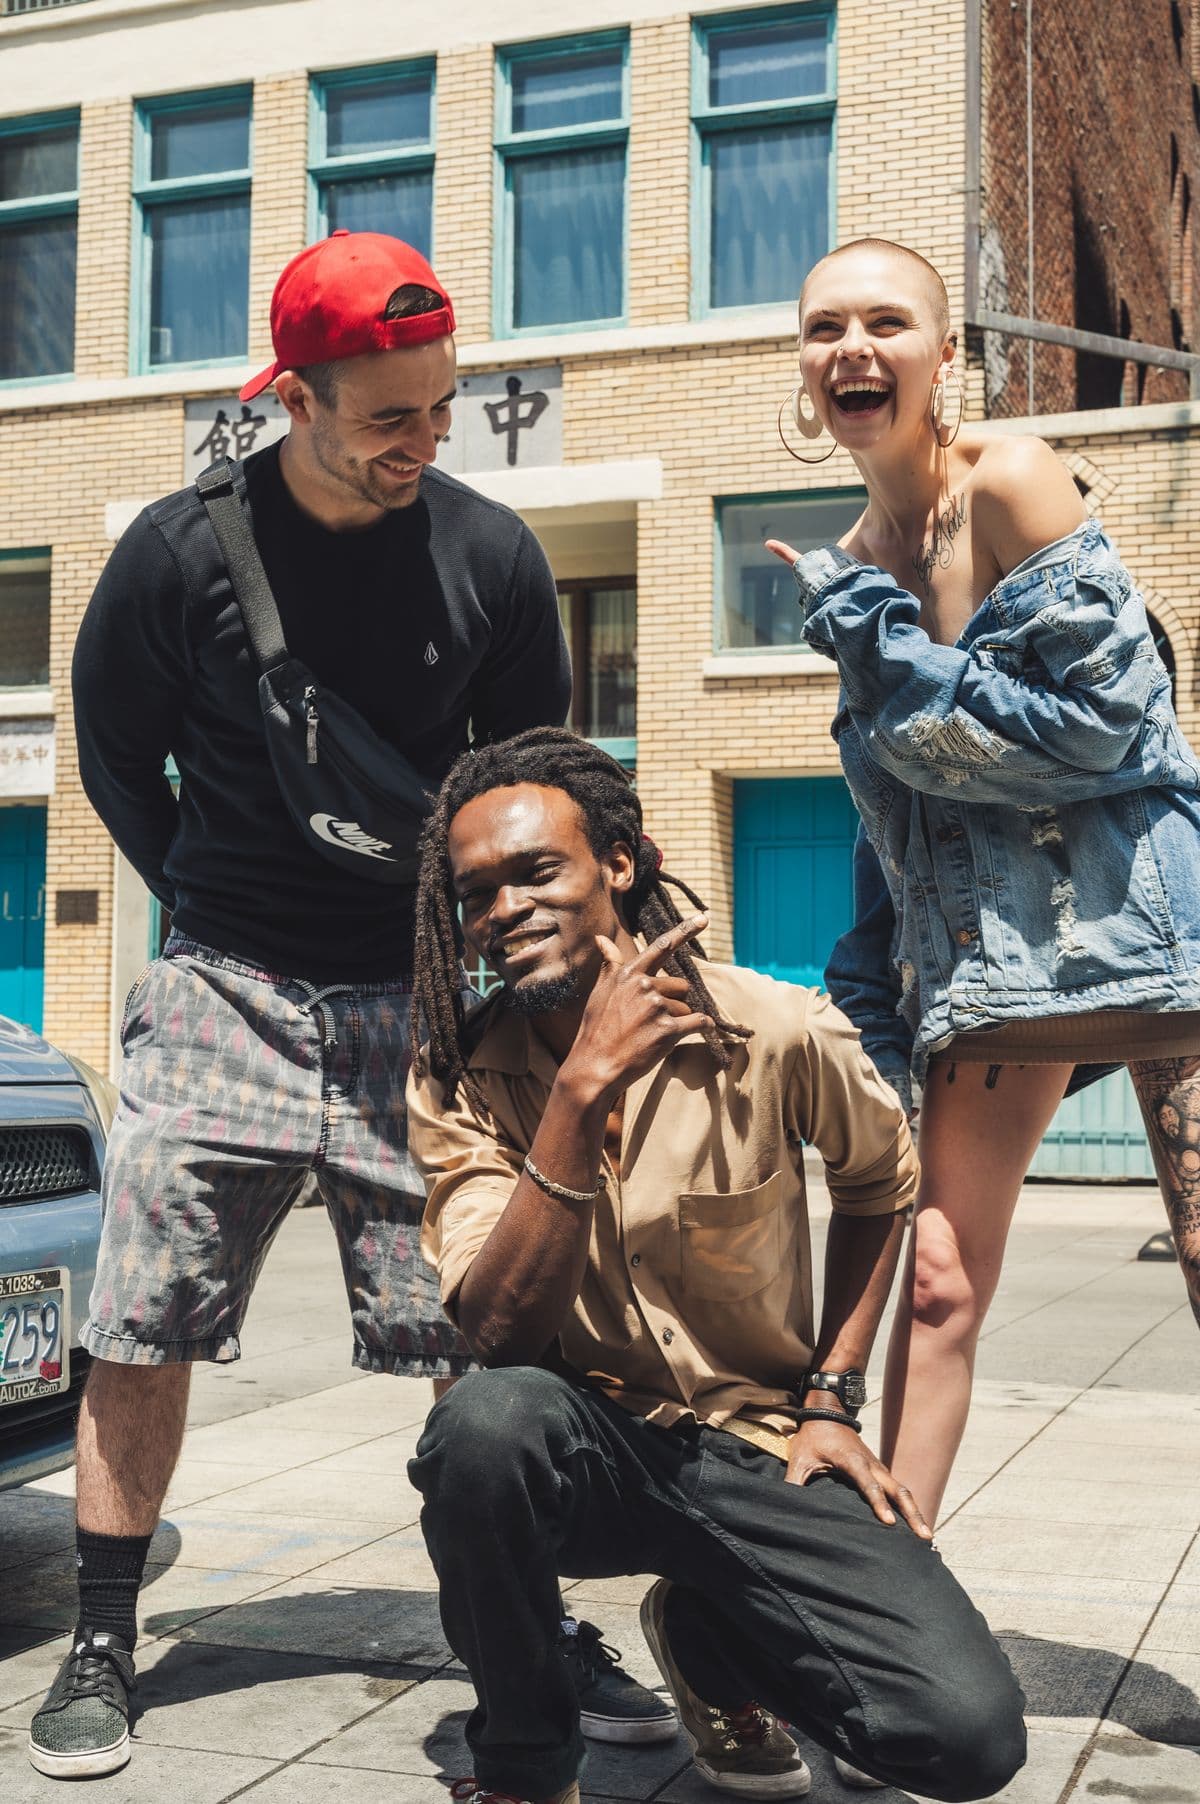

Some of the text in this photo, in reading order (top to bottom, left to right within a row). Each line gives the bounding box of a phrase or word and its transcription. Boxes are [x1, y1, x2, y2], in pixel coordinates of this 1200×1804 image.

[482, 376, 549, 466] 中
[331, 821, 393, 853] NIKE
[3, 1301, 59, 1369] 259
